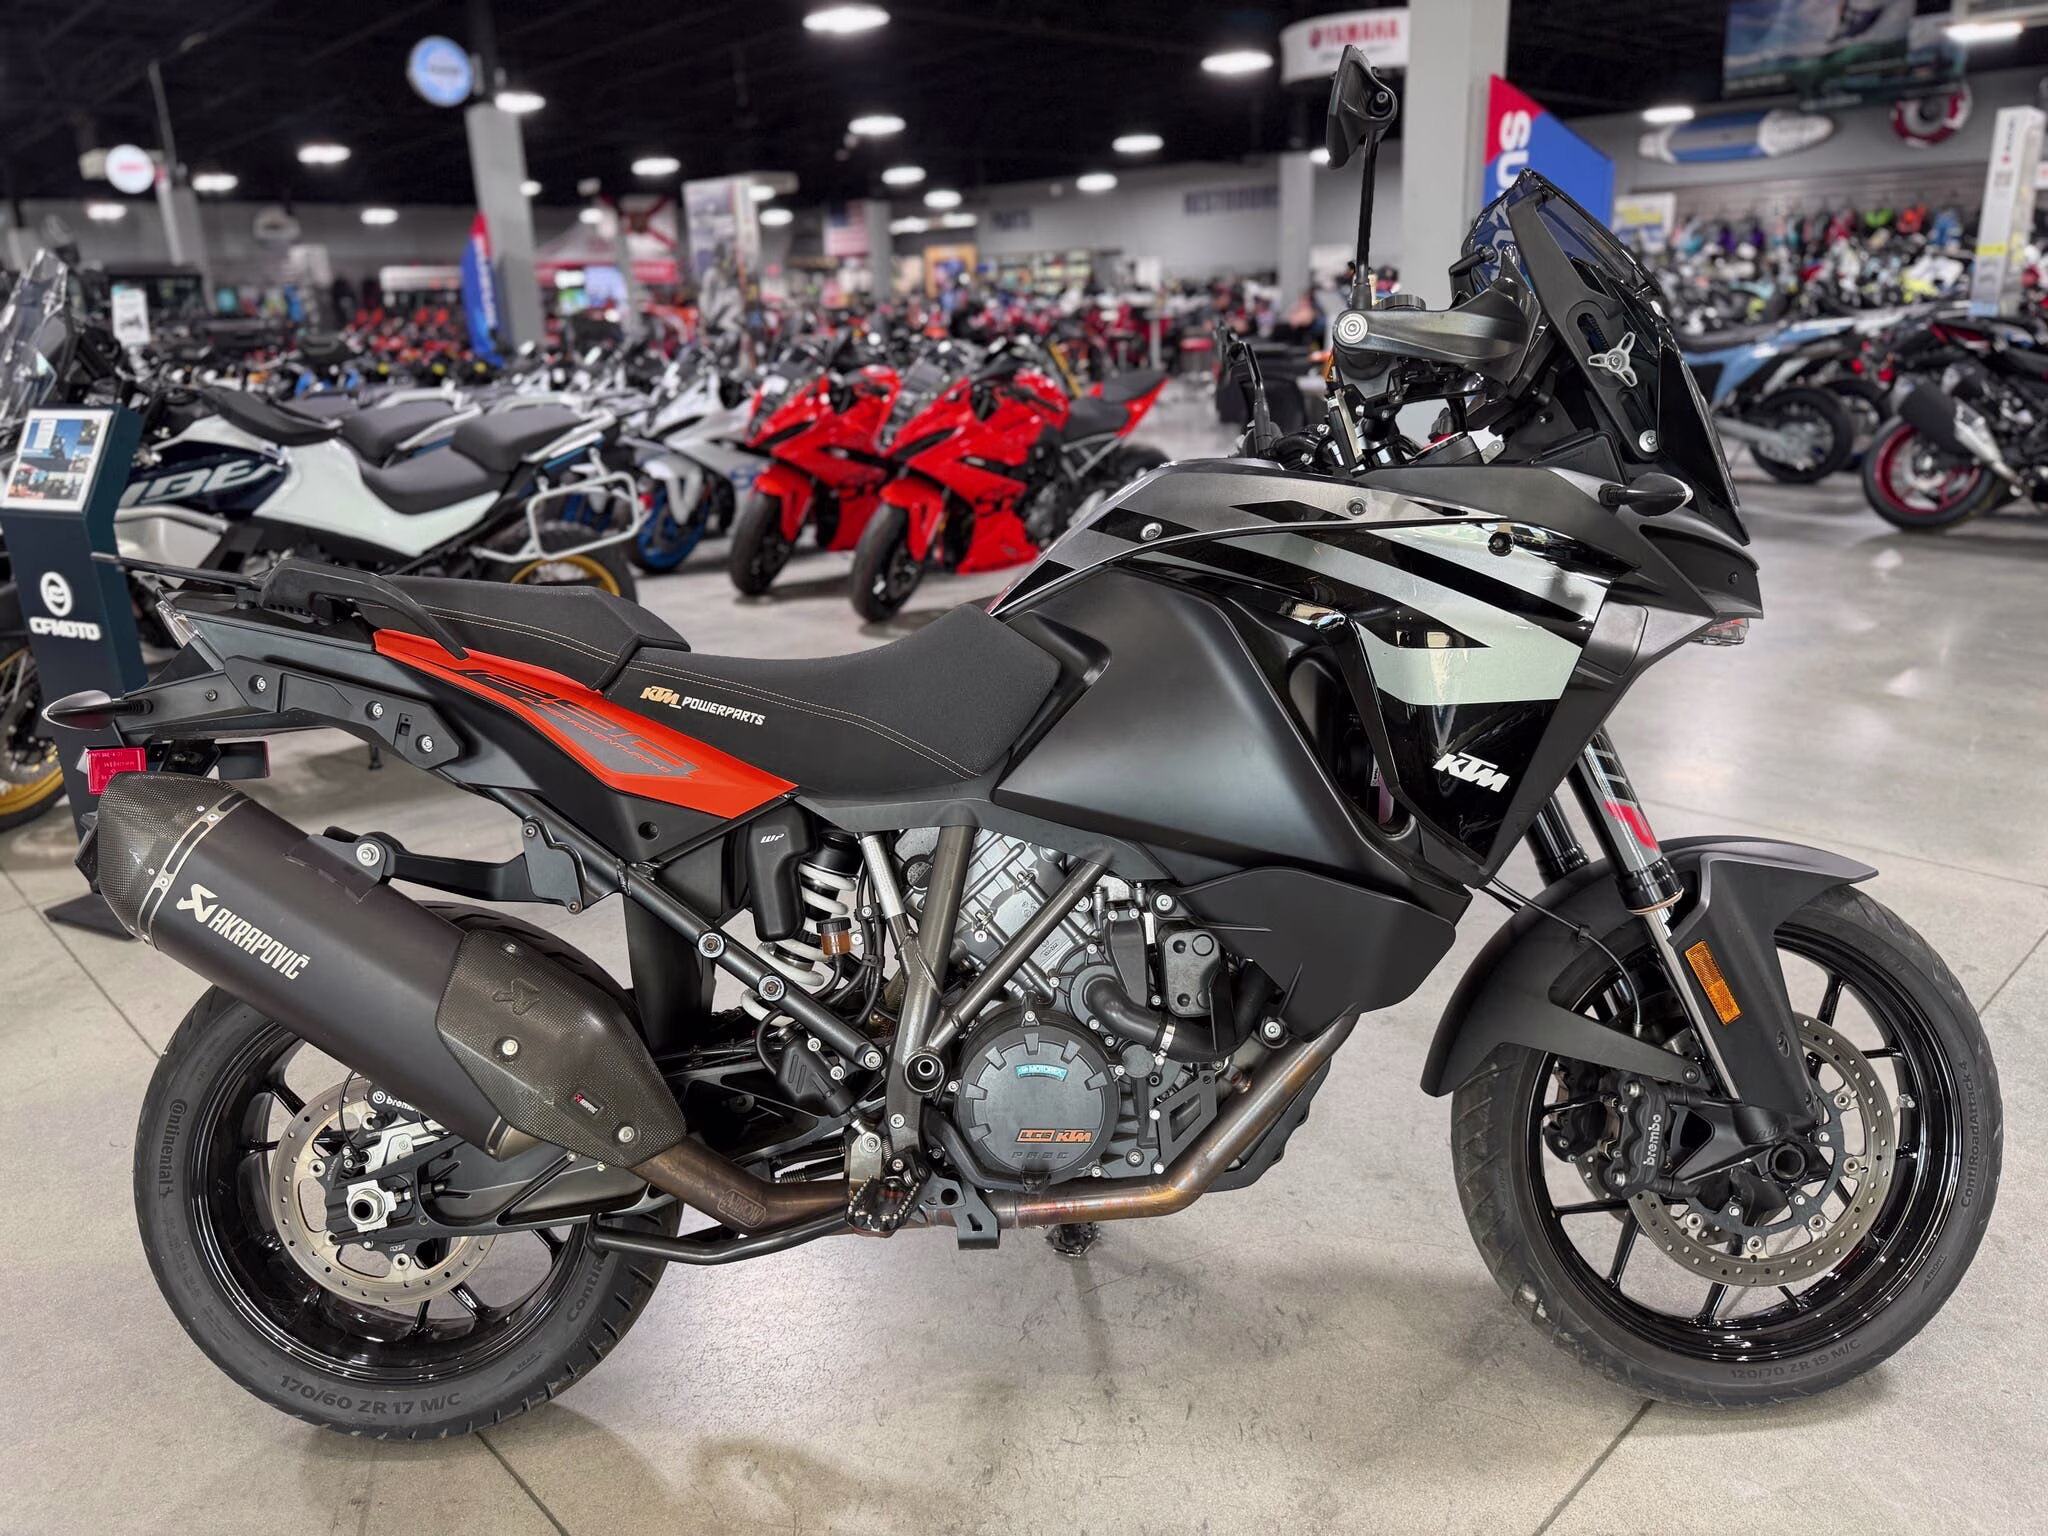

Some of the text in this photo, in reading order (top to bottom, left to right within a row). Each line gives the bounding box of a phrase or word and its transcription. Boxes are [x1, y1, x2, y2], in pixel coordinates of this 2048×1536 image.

[29, 616, 101, 641] CFMOTO
[640, 685, 766, 726] KTM POWERPARTS
[1432, 752, 1510, 793] KTM
[159, 1099, 188, 1185] Continental
[1055, 1129, 1092, 1142] KTM
[1643, 1114, 1661, 1166] brembo
[1730, 1338, 1861, 1380] 120/70 ZR 19 M/C
[280, 1374, 463, 1415] 170/60 ZR 17 M/C
